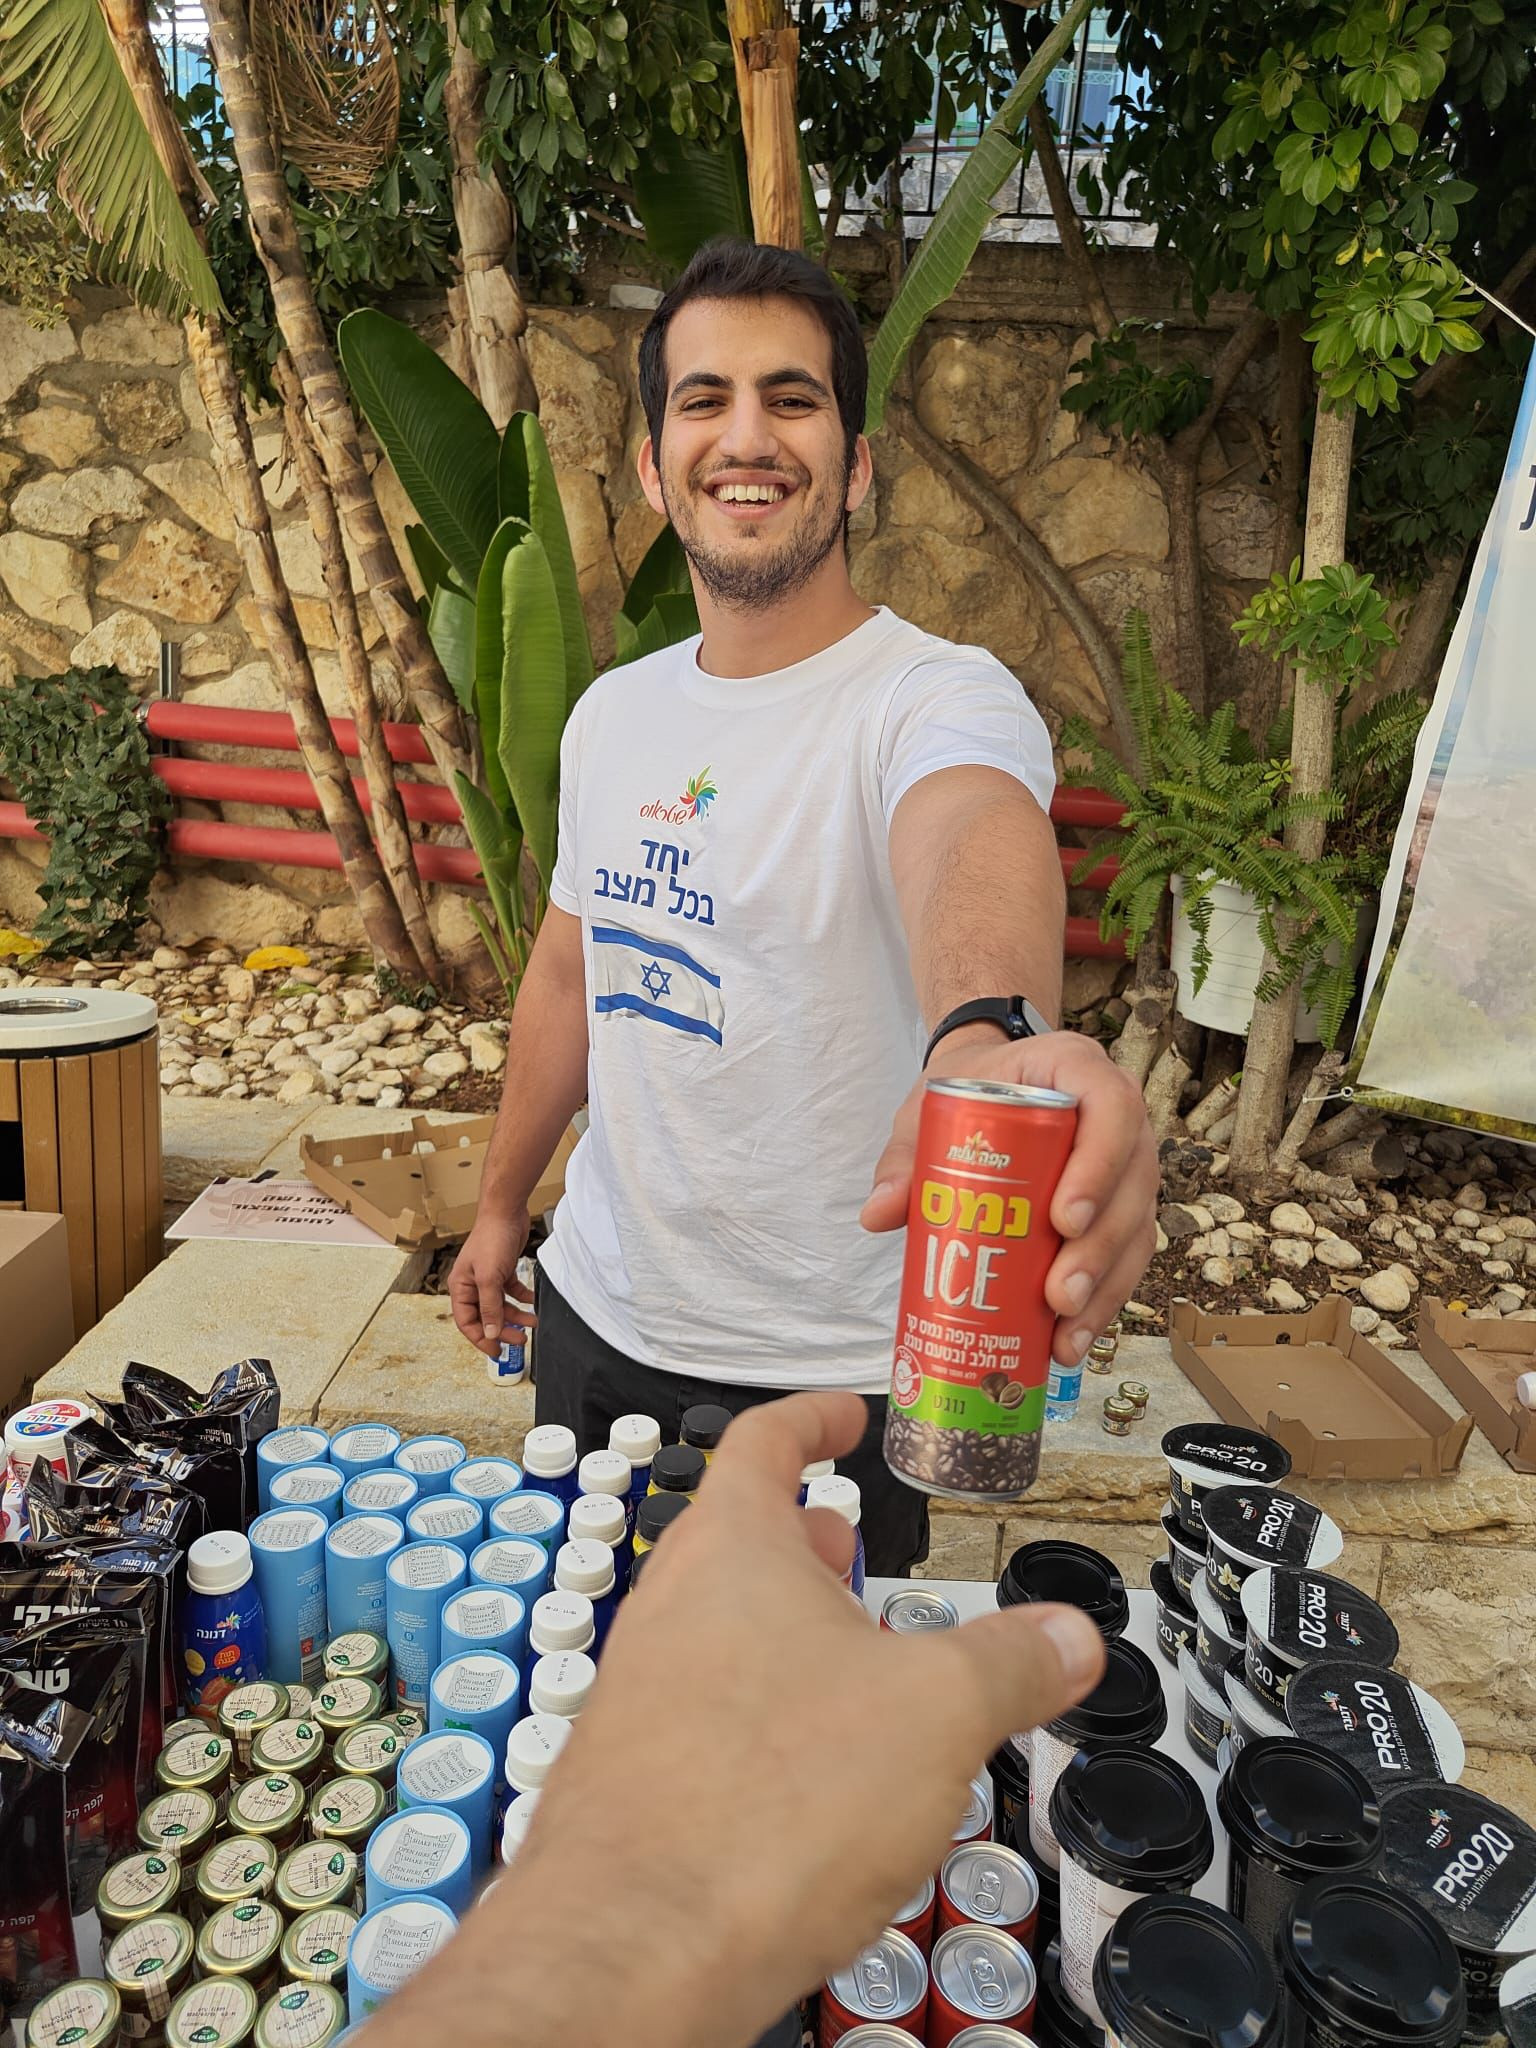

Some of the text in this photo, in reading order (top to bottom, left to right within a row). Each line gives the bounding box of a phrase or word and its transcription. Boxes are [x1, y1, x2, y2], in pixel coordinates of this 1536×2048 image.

[640, 839, 690, 876] יחד
[594, 868, 715, 926] בכל מצב
[978, 1151, 1011, 1168] קפה
[921, 1179, 1031, 1238] נמס
[923, 1234, 1008, 1311] ICE
[906, 1313, 1021, 1352] משקה קפה נמס קר
[925, 1340, 966, 1365] ובטעם
[969, 1348, 997, 1369] חלב
[1000, 1354, 1020, 1370] עם
[933, 1394, 966, 1415] נוגט
[222, 1432, 232, 1446] 10
[160, 1519, 173, 1536] 10
[141, 1560, 158, 1572] 10
[113, 1618, 128, 1628] 10
[196, 1629, 226, 1639] דנונה
[218, 1656, 236, 1665] בננה
[220, 1650, 235, 1658] תות
[1338, 1704, 1354, 1732] דנונה
[47, 1732, 64, 1754] 10
[83, 1793, 104, 1813] קפה
[1426, 1823, 1451, 1849] דנונה
[1483, 1863, 1497, 1879] גרם
[1472, 1875, 1489, 1896] חלבון
[10, 1914, 36, 1927] קפה
[384, 1927, 420, 1939] OPEN HERE
[391, 1938, 413, 1948] SHAKE
[376, 1949, 395, 1958] OPEN
